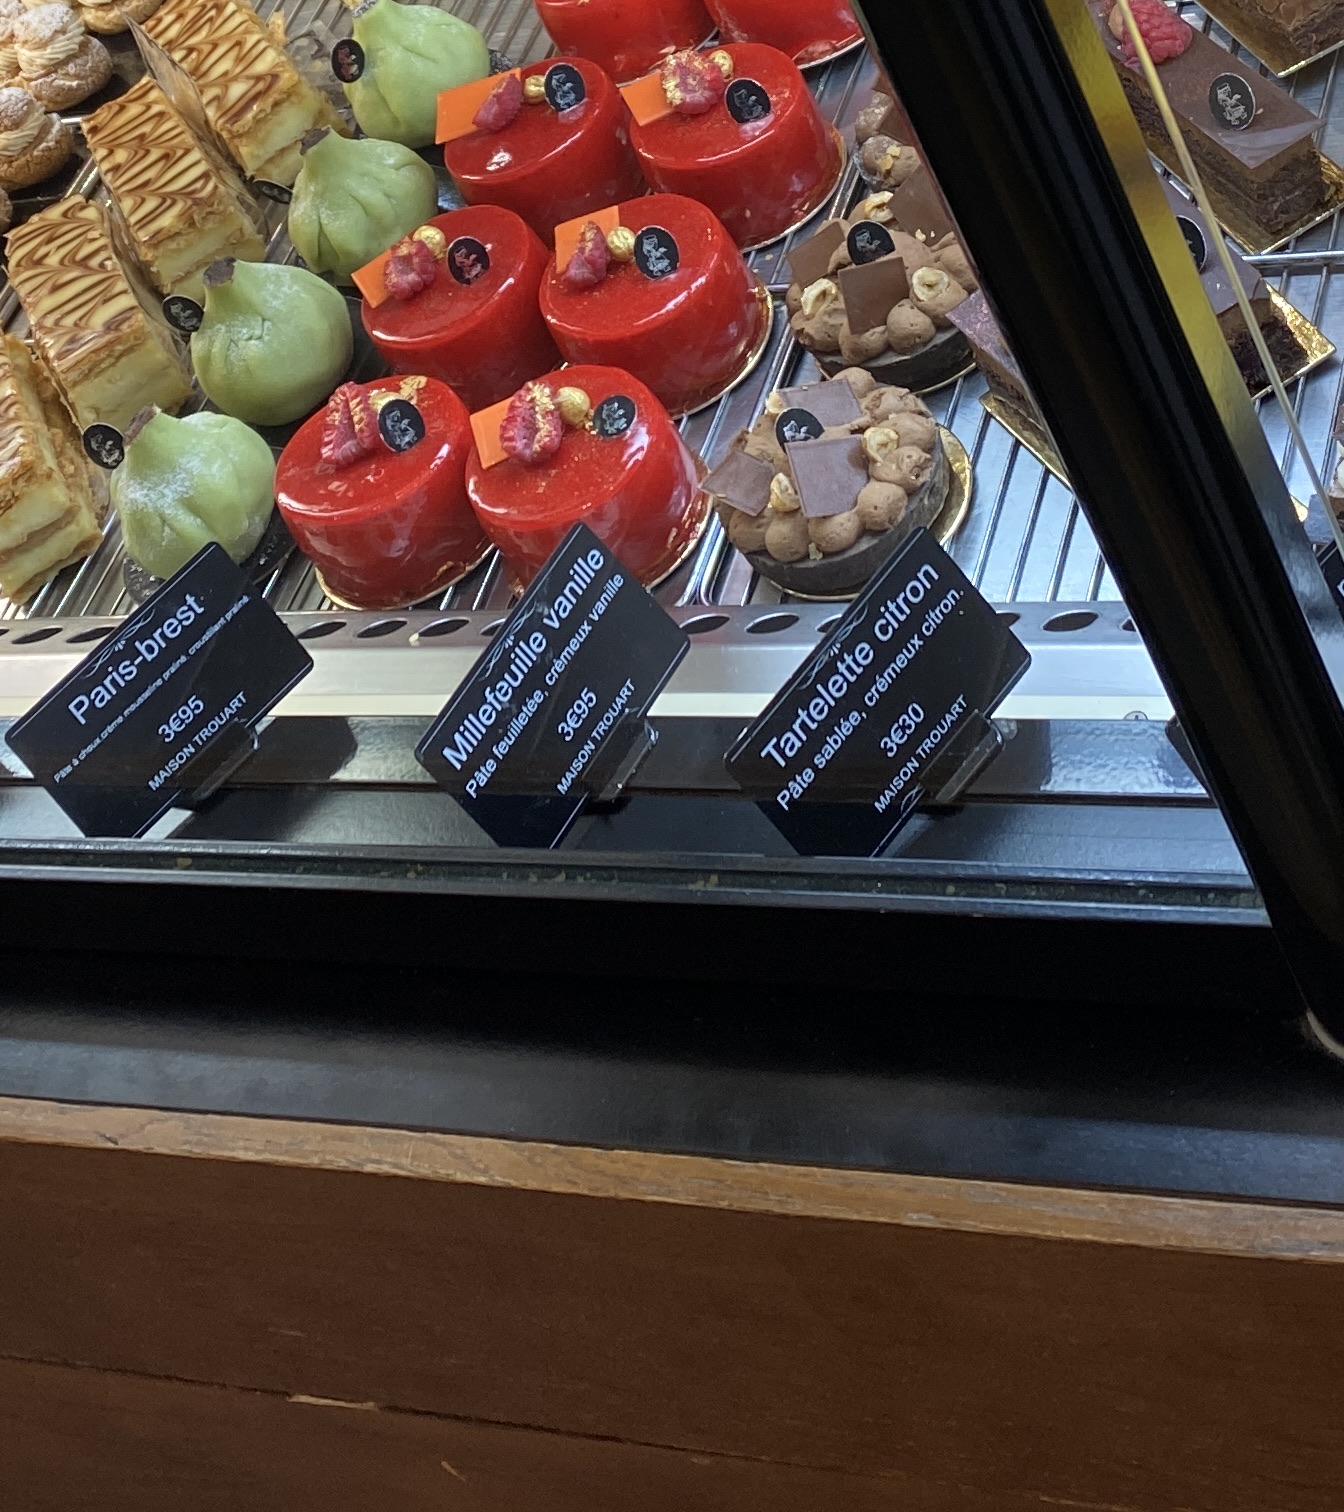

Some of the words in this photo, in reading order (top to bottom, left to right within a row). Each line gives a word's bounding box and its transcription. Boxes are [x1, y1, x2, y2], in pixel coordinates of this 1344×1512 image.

[68, 593, 205, 726] Paris-brest
[158, 694, 205, 743] 3€95
[442, 632, 548, 771] Millefeuille
[543, 547, 606, 632] vanille
[465, 757, 497, 800] Pâte
[492, 690, 549, 761] feuilletée,
[589, 573, 624, 627] vanille
[557, 687, 598, 743] 3€95
[760, 642, 875, 769] Tartelette
[873, 562, 941, 643] citron
[776, 767, 816, 812] Pâte
[813, 709, 868, 770] sablée,
[863, 633, 924, 708] crémeux
[923, 589, 965, 638] citron.
[148, 743, 196, 791] MAISON
[193, 691, 247, 747] TROUART
[556, 746, 596, 796] MAISON
[590, 678, 636, 741] TROUART
[874, 761, 919, 814] MAISON
[916, 694, 968, 759] TROUART
[880, 702, 925, 759] 3€30
